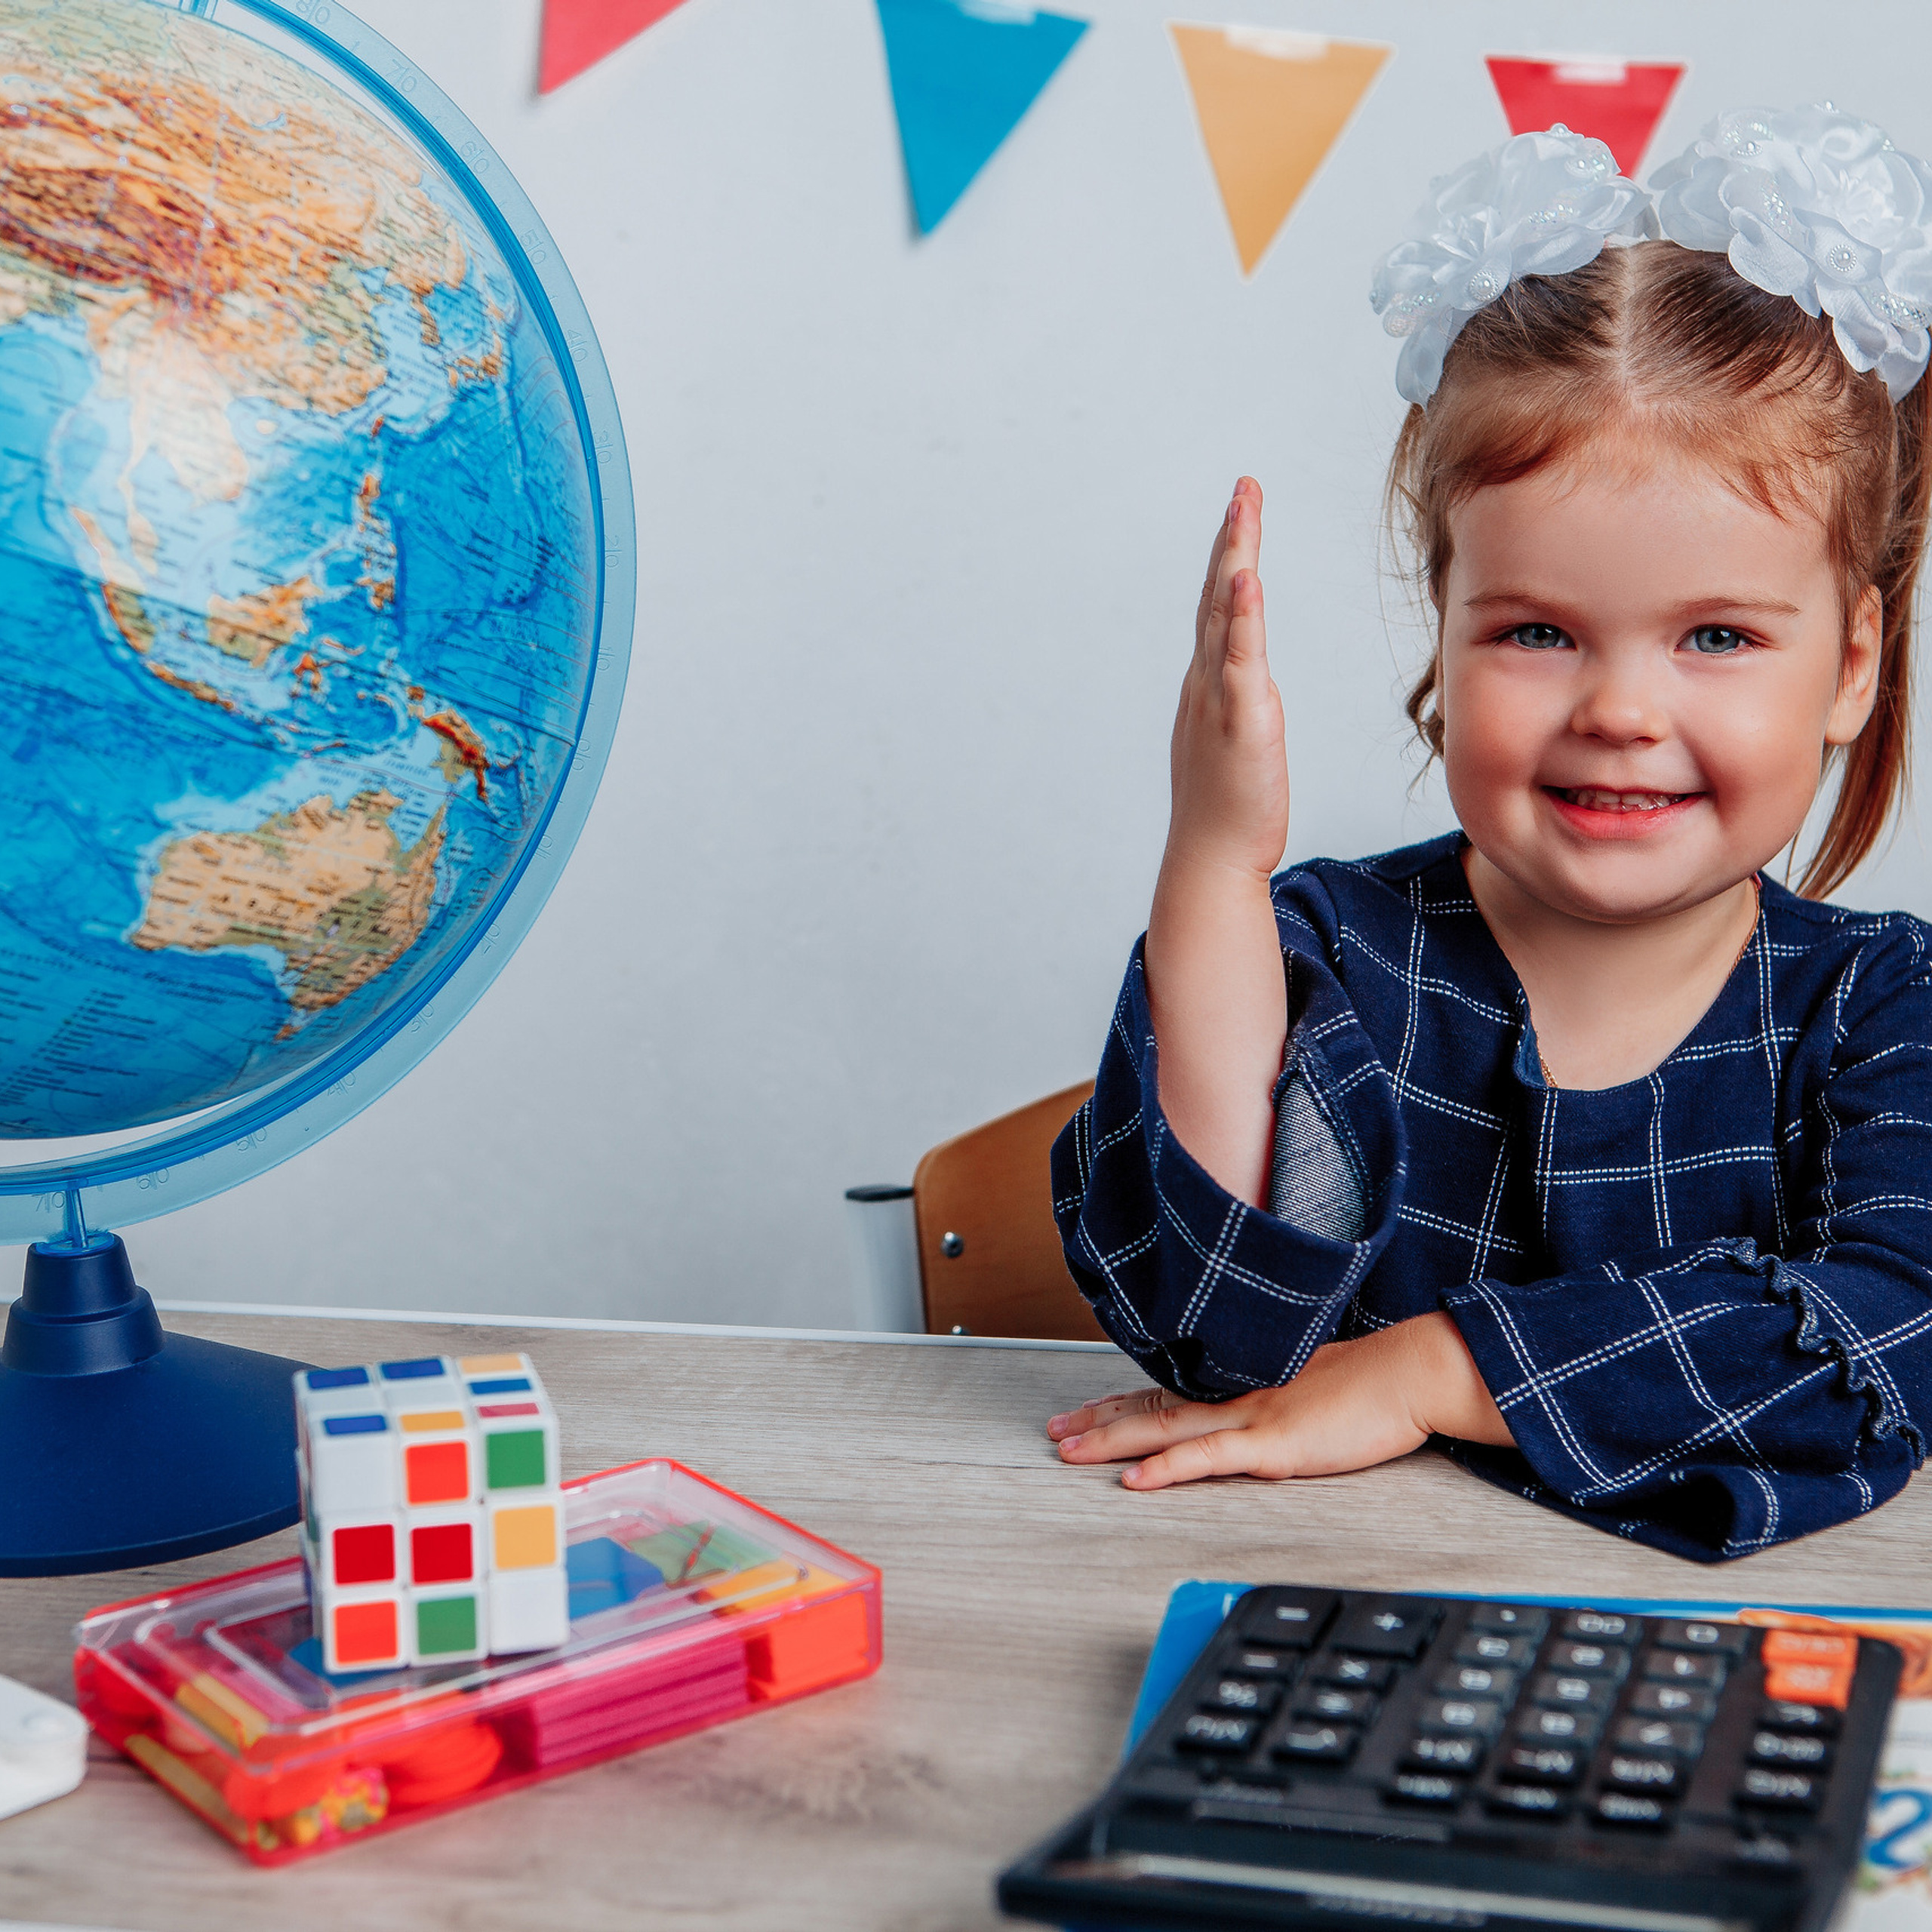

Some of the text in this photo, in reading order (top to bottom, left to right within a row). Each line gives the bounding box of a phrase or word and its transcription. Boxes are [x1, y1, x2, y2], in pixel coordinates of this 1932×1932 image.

[460, 141, 489, 174] 60
[521, 229, 546, 265] 50
[567, 328, 588, 362] 40
[594, 429, 612, 466] 30
[605, 534, 621, 568] 20
